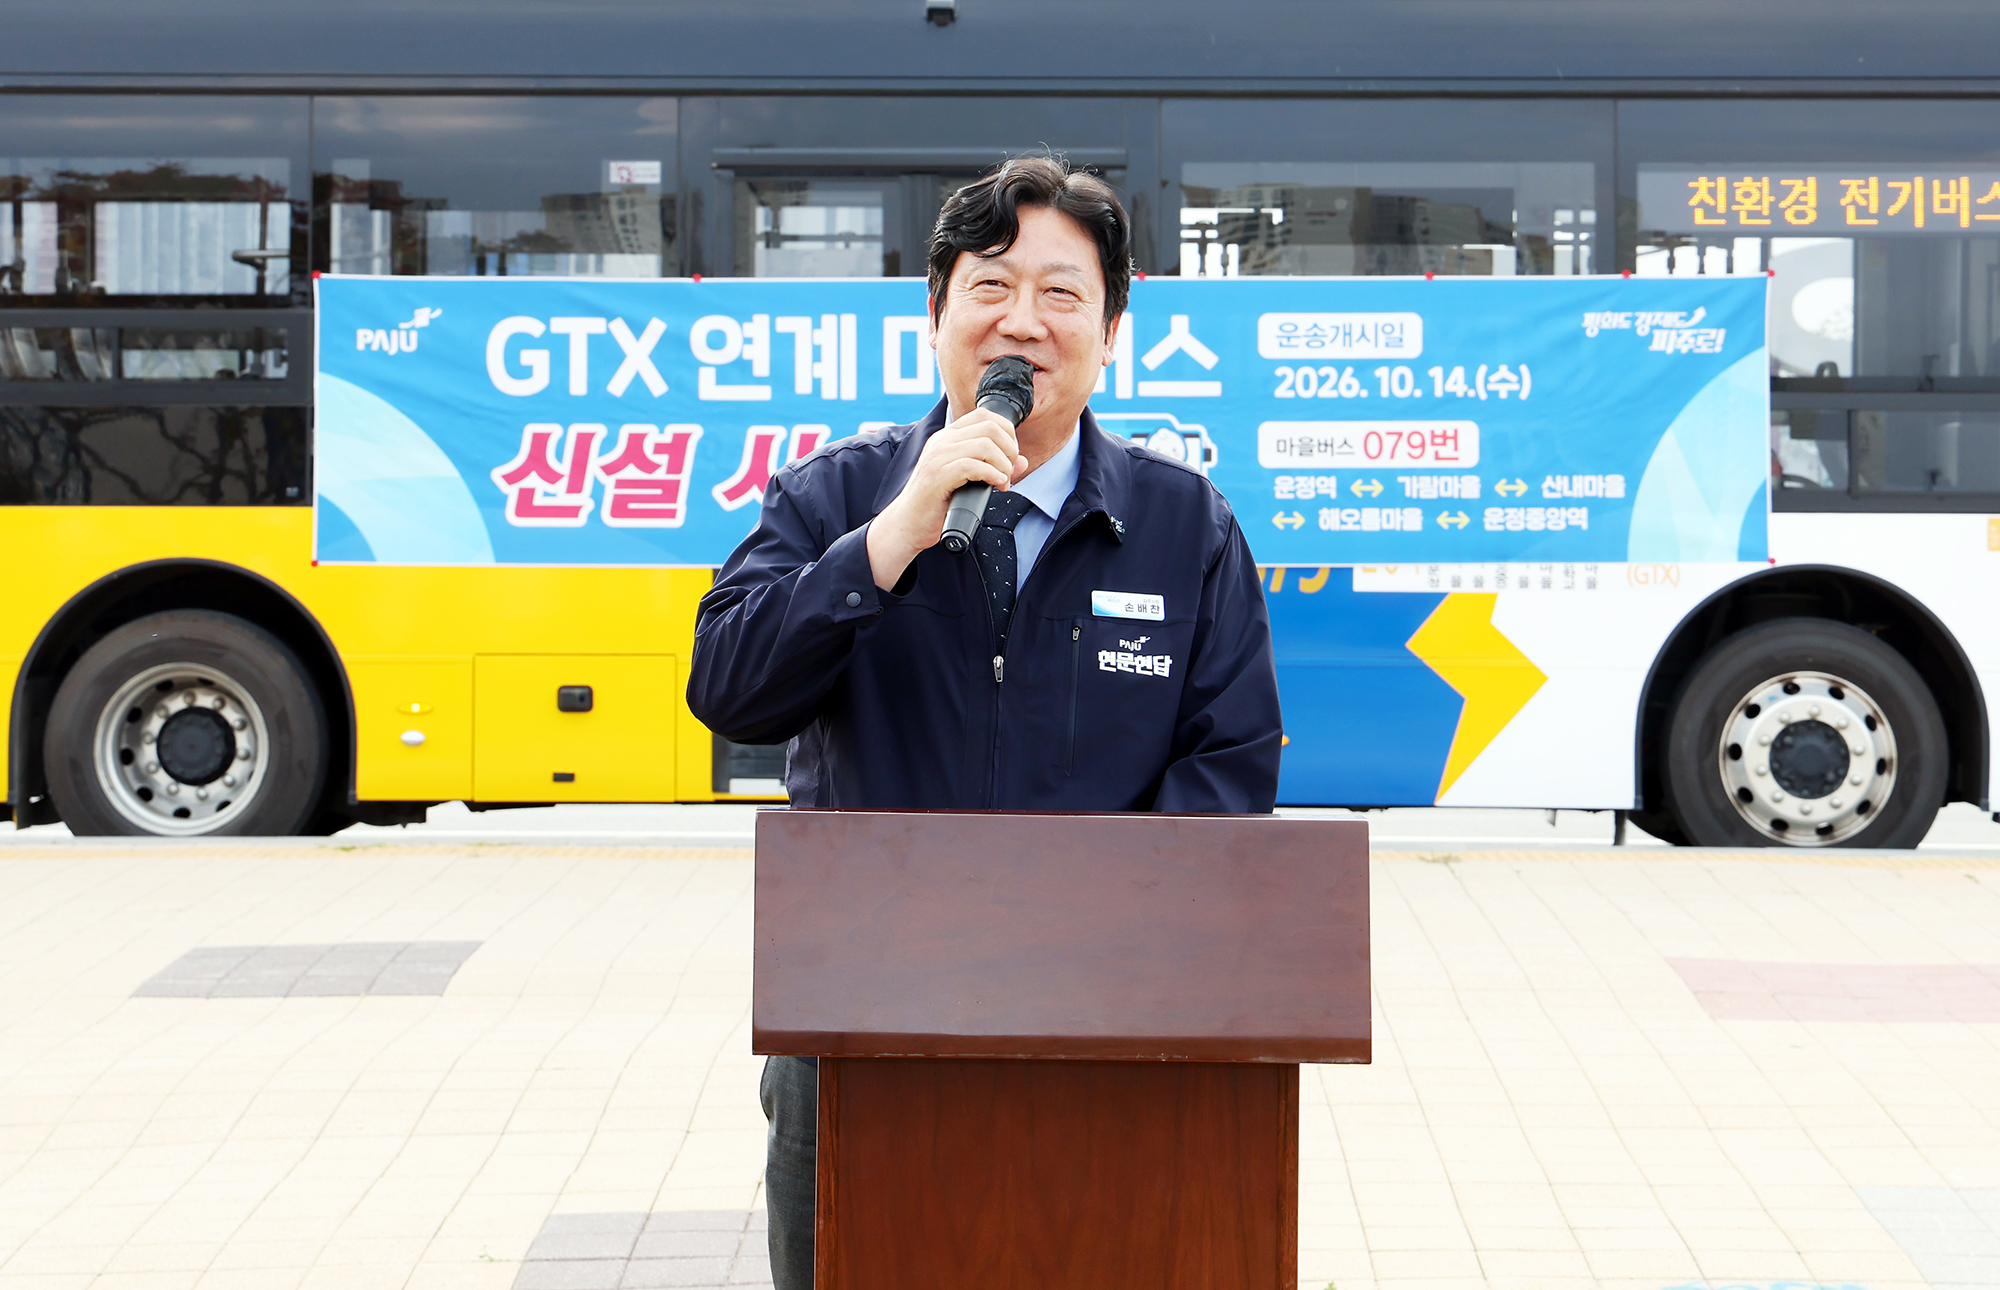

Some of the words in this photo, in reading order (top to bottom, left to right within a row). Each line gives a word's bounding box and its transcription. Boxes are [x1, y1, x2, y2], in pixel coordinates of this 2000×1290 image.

[1687, 176, 1818, 225] 친환경
[355, 326, 420, 356] PAJU
[1275, 321, 1405, 350] 운송개시일
[1648, 327, 1726, 355] 파주로!
[486, 316, 669, 399] GTX
[689, 313, 857, 400] 연계
[1273, 366, 1367, 399] 2026.
[1374, 366, 1422, 399] 10.
[1428, 364, 1532, 401] 14.(수)
[1276, 437, 1356, 458] 마을버스
[1363, 428, 1461, 461] 079번
[493, 425, 701, 525] 신설
[1273, 475, 1337, 500] 운정역
[1397, 474, 1481, 499] 가람마을
[1541, 473, 1625, 499] 산내마을
[1318, 506, 1423, 532] 해오름마을
[1483, 506, 1589, 532] 운정중앙역
[1627, 563, 1681, 588] (GTX)
[1119, 638, 1142, 652] PAJU
[1097, 649, 1173, 678] 현문현답
